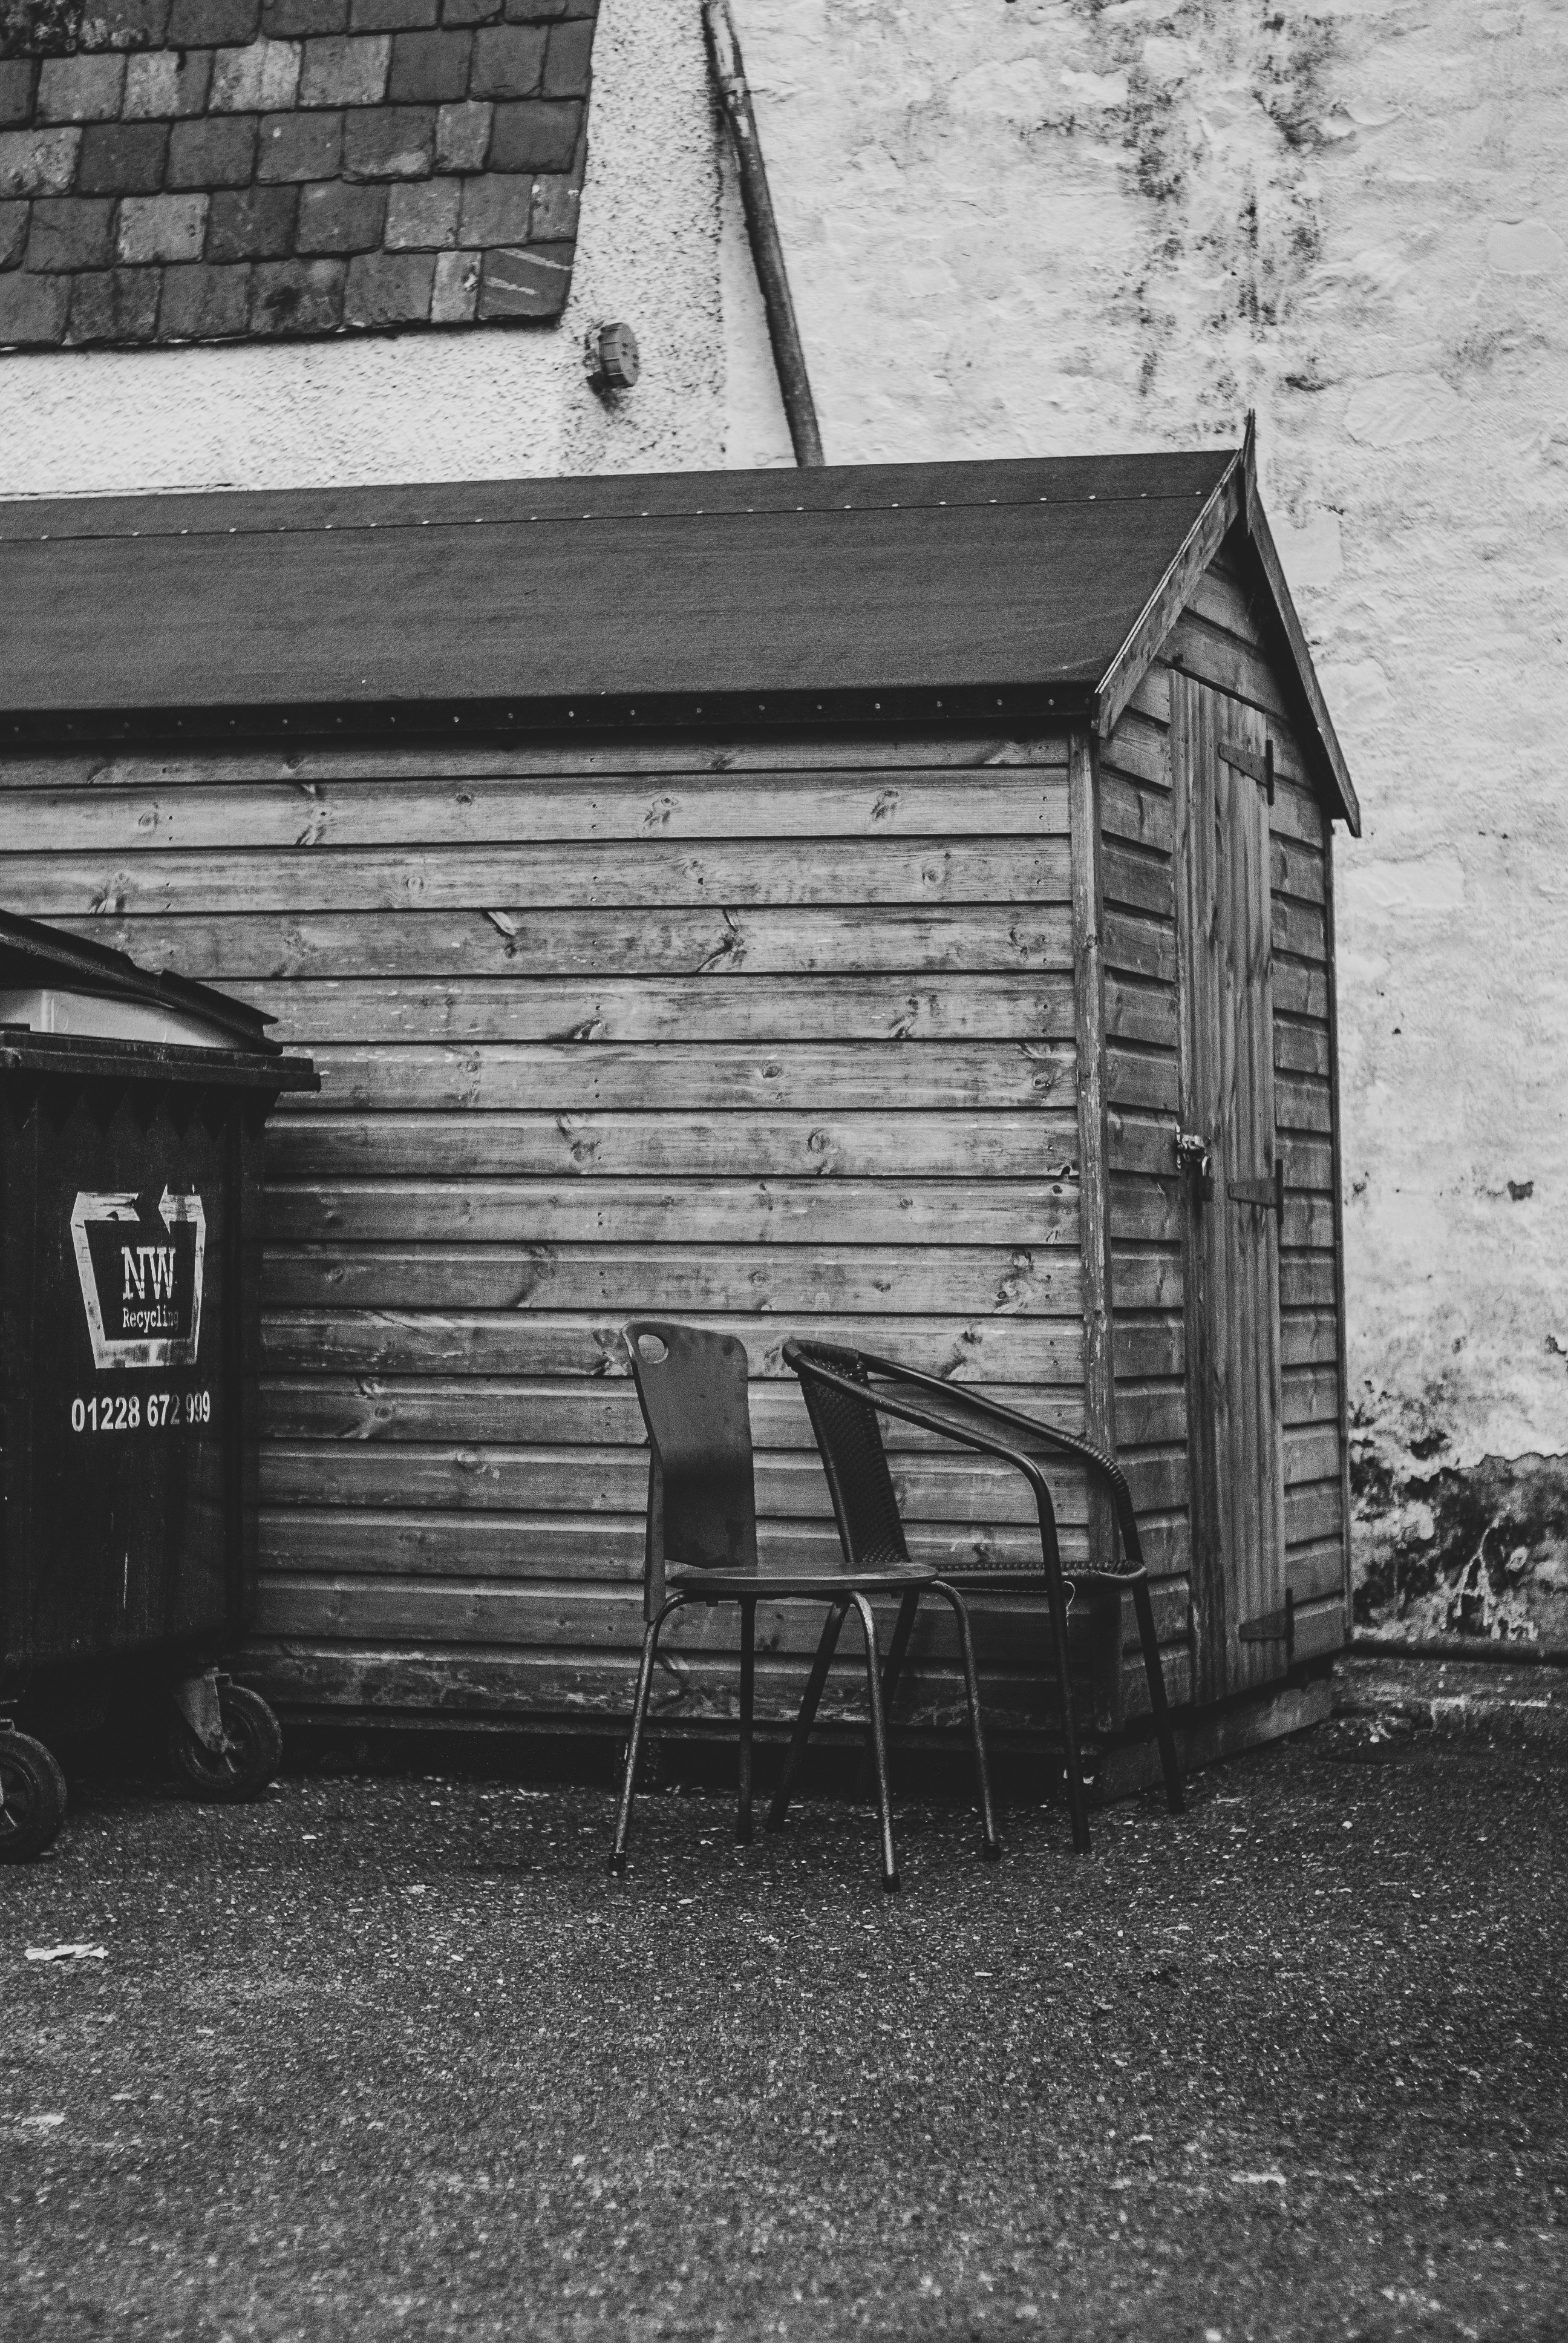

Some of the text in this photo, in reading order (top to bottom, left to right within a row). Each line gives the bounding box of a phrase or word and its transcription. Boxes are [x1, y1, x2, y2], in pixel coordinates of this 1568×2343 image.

[121, 1247, 176, 1300] NW
[122, 1305, 179, 1333] Recycling
[71, 1391, 211, 1432] 01228 672 999
